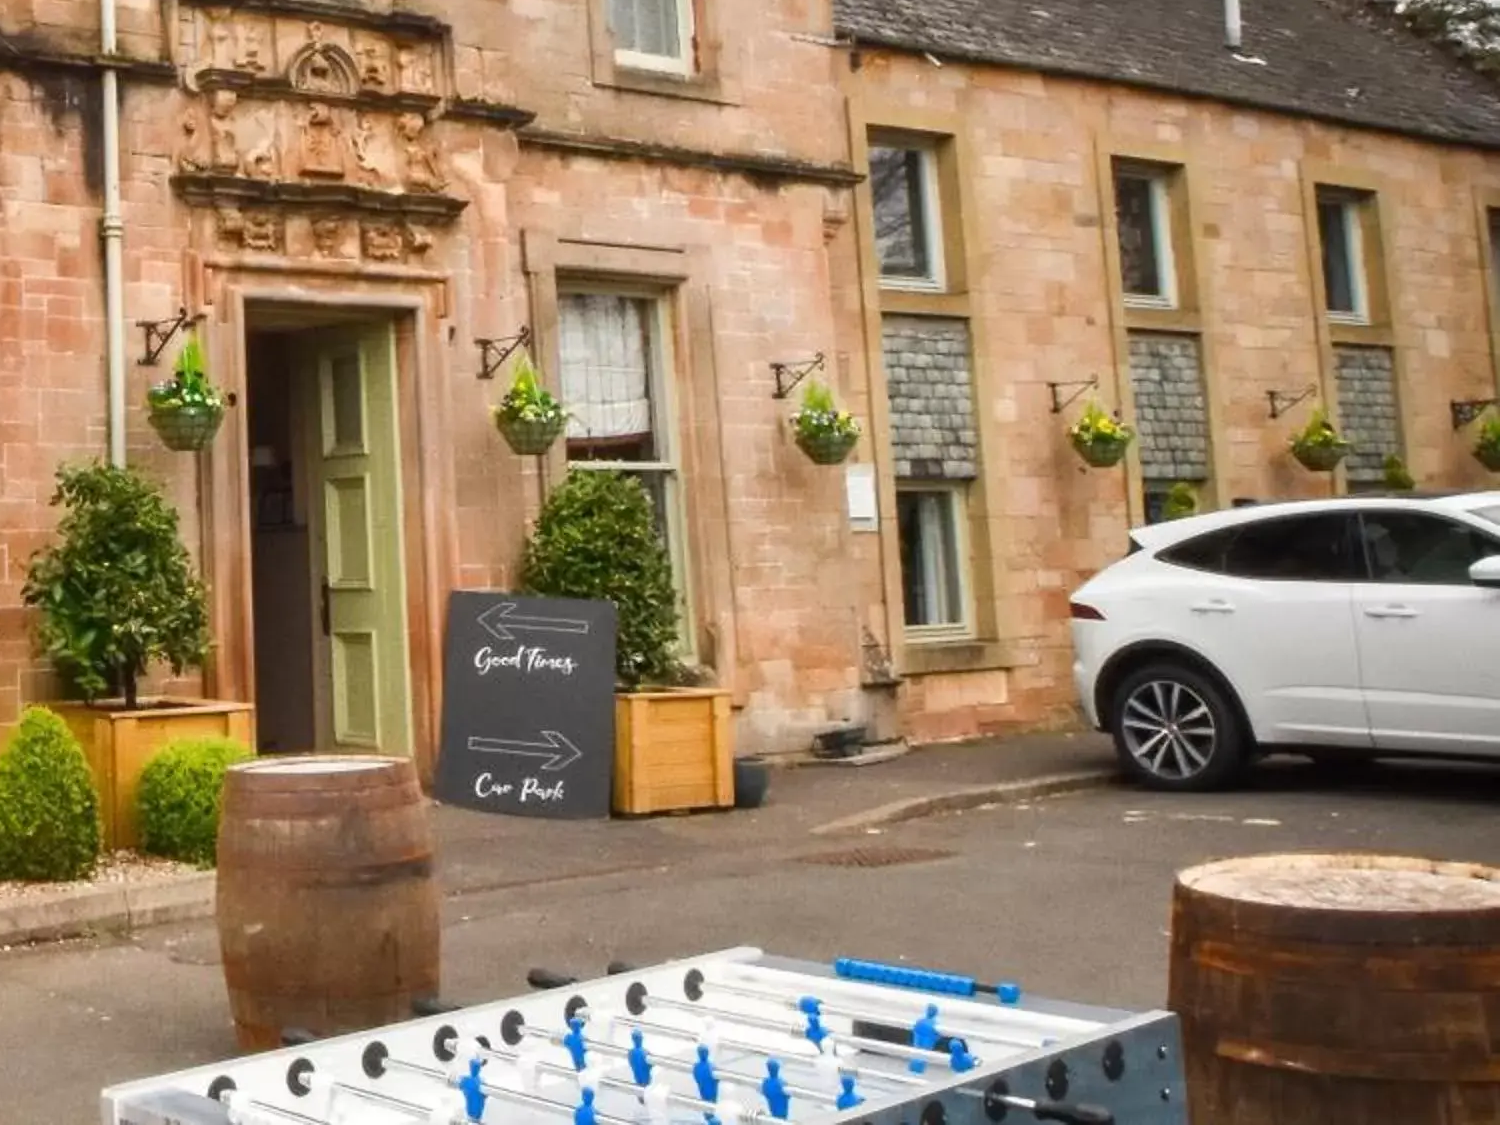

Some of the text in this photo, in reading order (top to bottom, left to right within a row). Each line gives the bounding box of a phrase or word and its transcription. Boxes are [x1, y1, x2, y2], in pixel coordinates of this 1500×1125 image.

[474, 645, 579, 675] Good Times
[475, 772, 564, 802] Car Park
